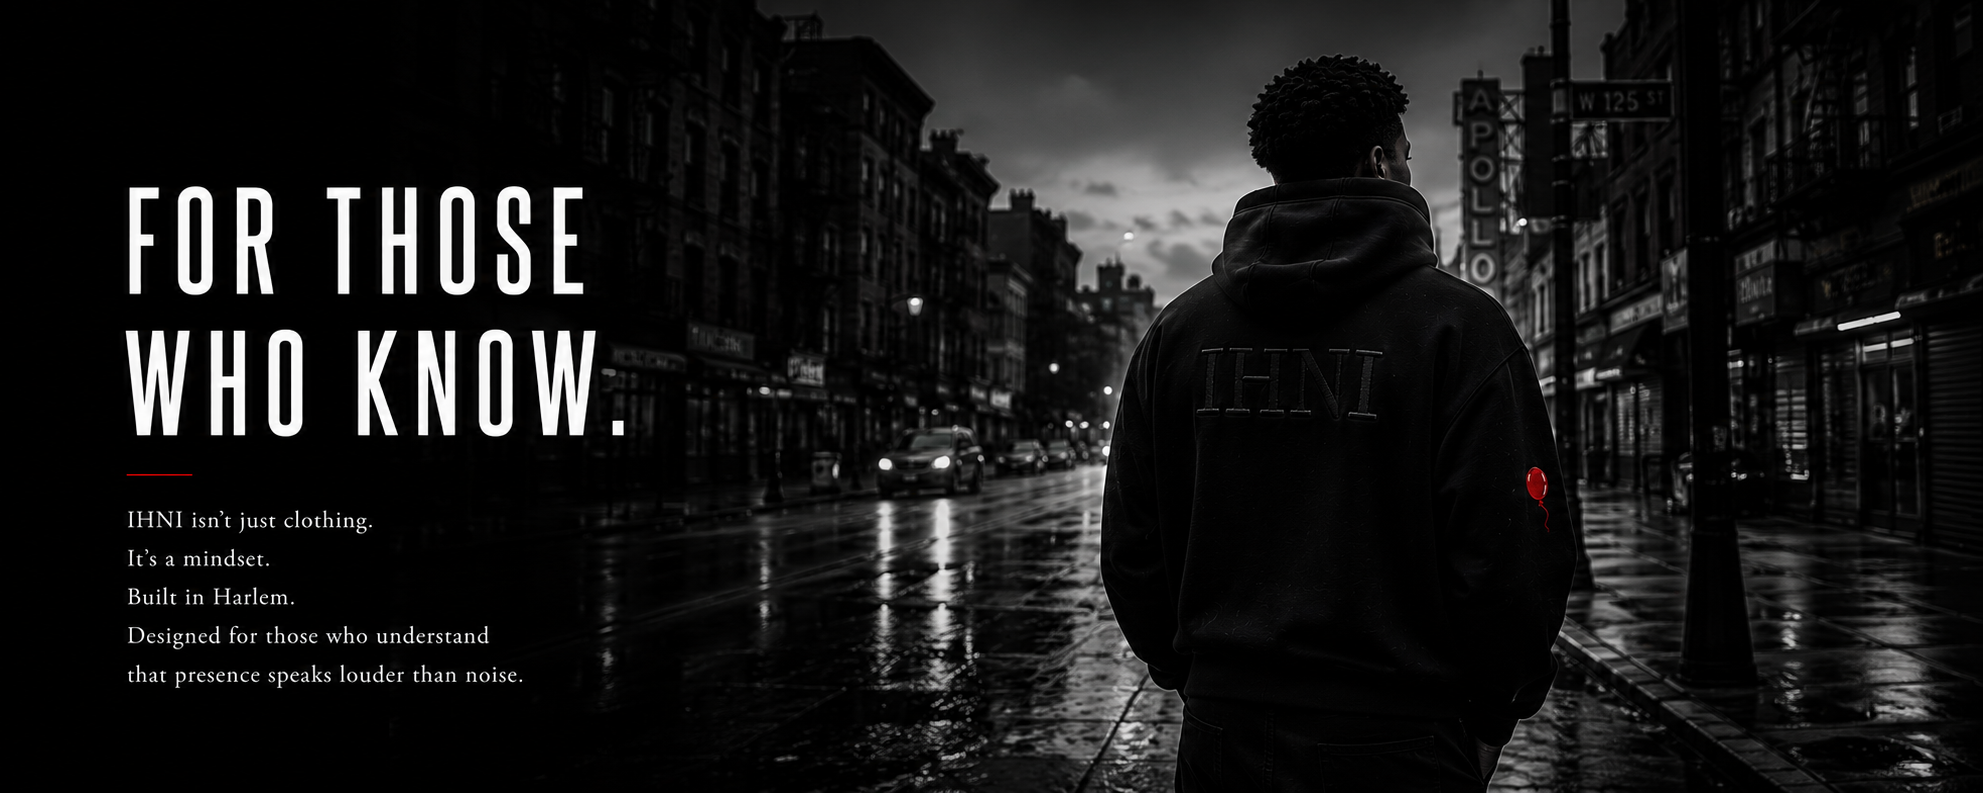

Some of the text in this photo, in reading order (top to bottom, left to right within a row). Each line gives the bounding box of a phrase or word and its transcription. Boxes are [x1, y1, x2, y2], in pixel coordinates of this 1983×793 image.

[1578, 89, 1665, 113] W 125 ST
[1466, 86, 1497, 285] APOLLO
[1195, 347, 1384, 420] IHNI
